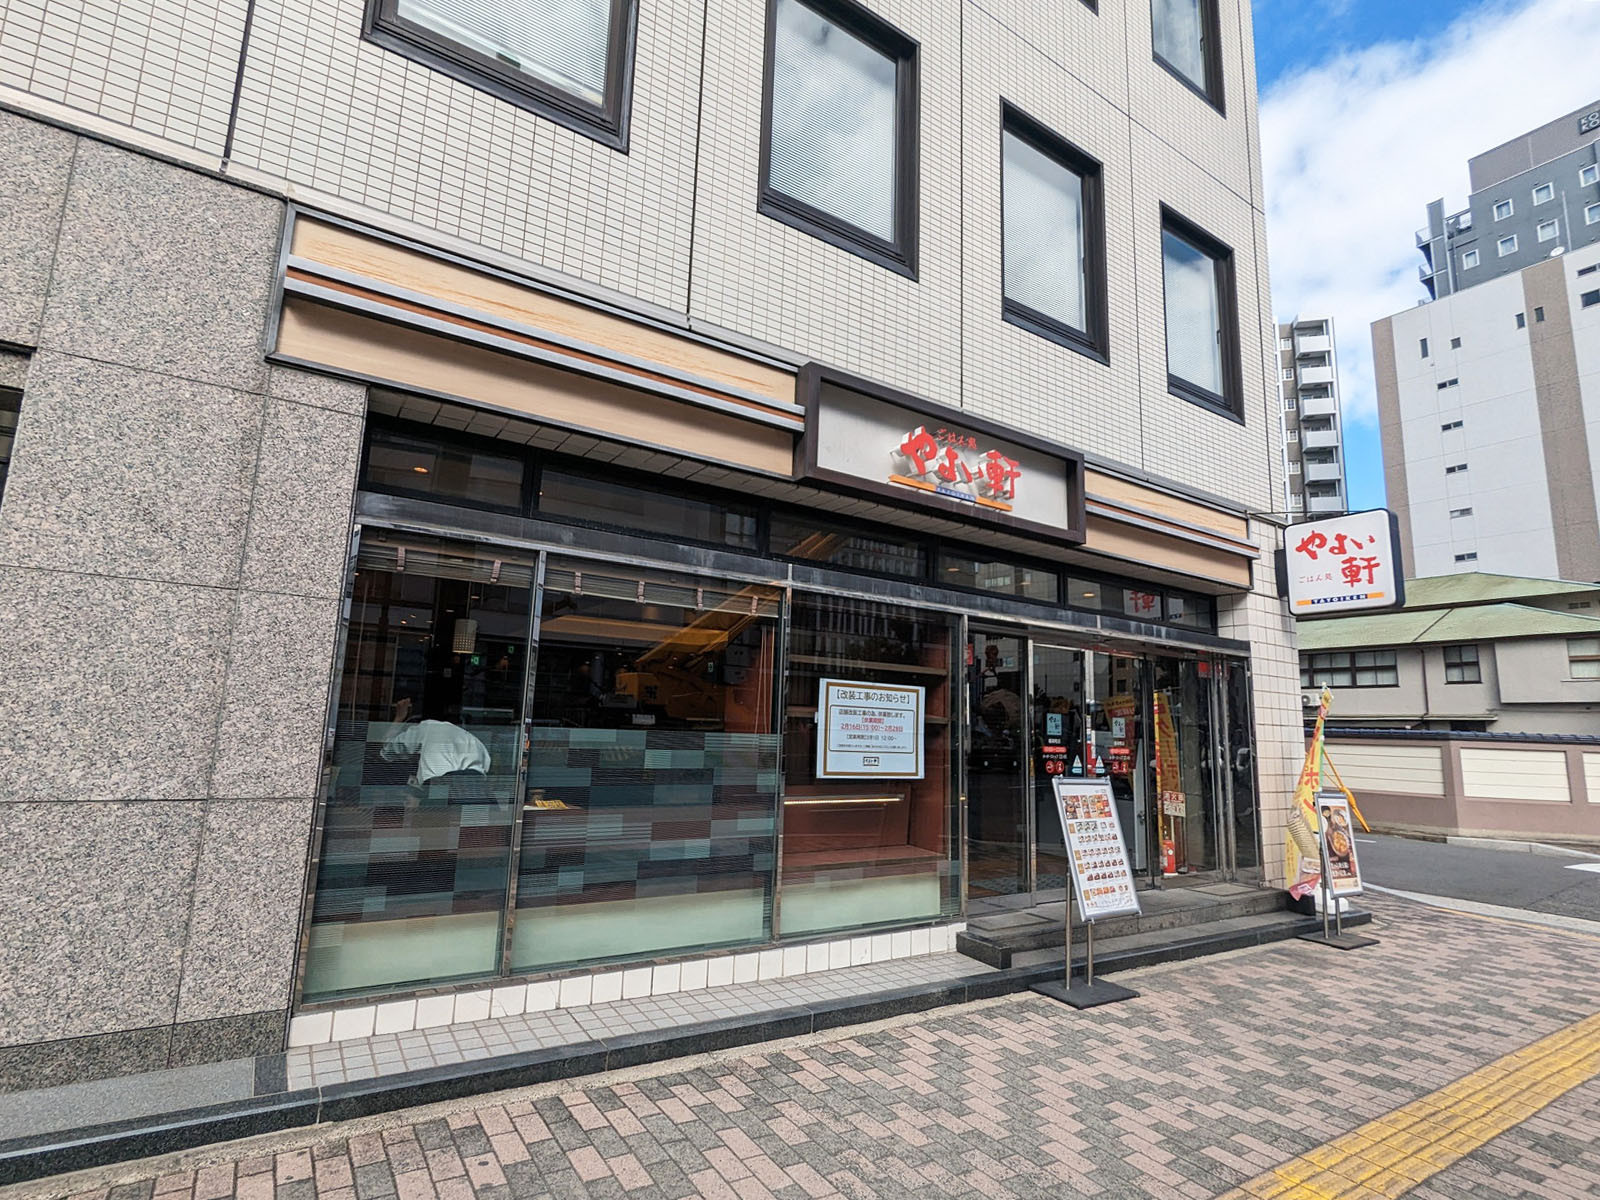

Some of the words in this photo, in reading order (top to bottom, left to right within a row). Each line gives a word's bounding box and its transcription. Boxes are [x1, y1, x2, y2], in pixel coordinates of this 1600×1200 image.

[901, 425, 1021, 499] やよい軒
[1296, 530, 1375, 560] やよい
[1298, 572, 1333, 584] ごはん処
[1341, 557, 1381, 587] 軒
[1313, 593, 1367, 605] YAYOIKEN
[837, 690, 910, 704] 【改装工事のお知らせ】
